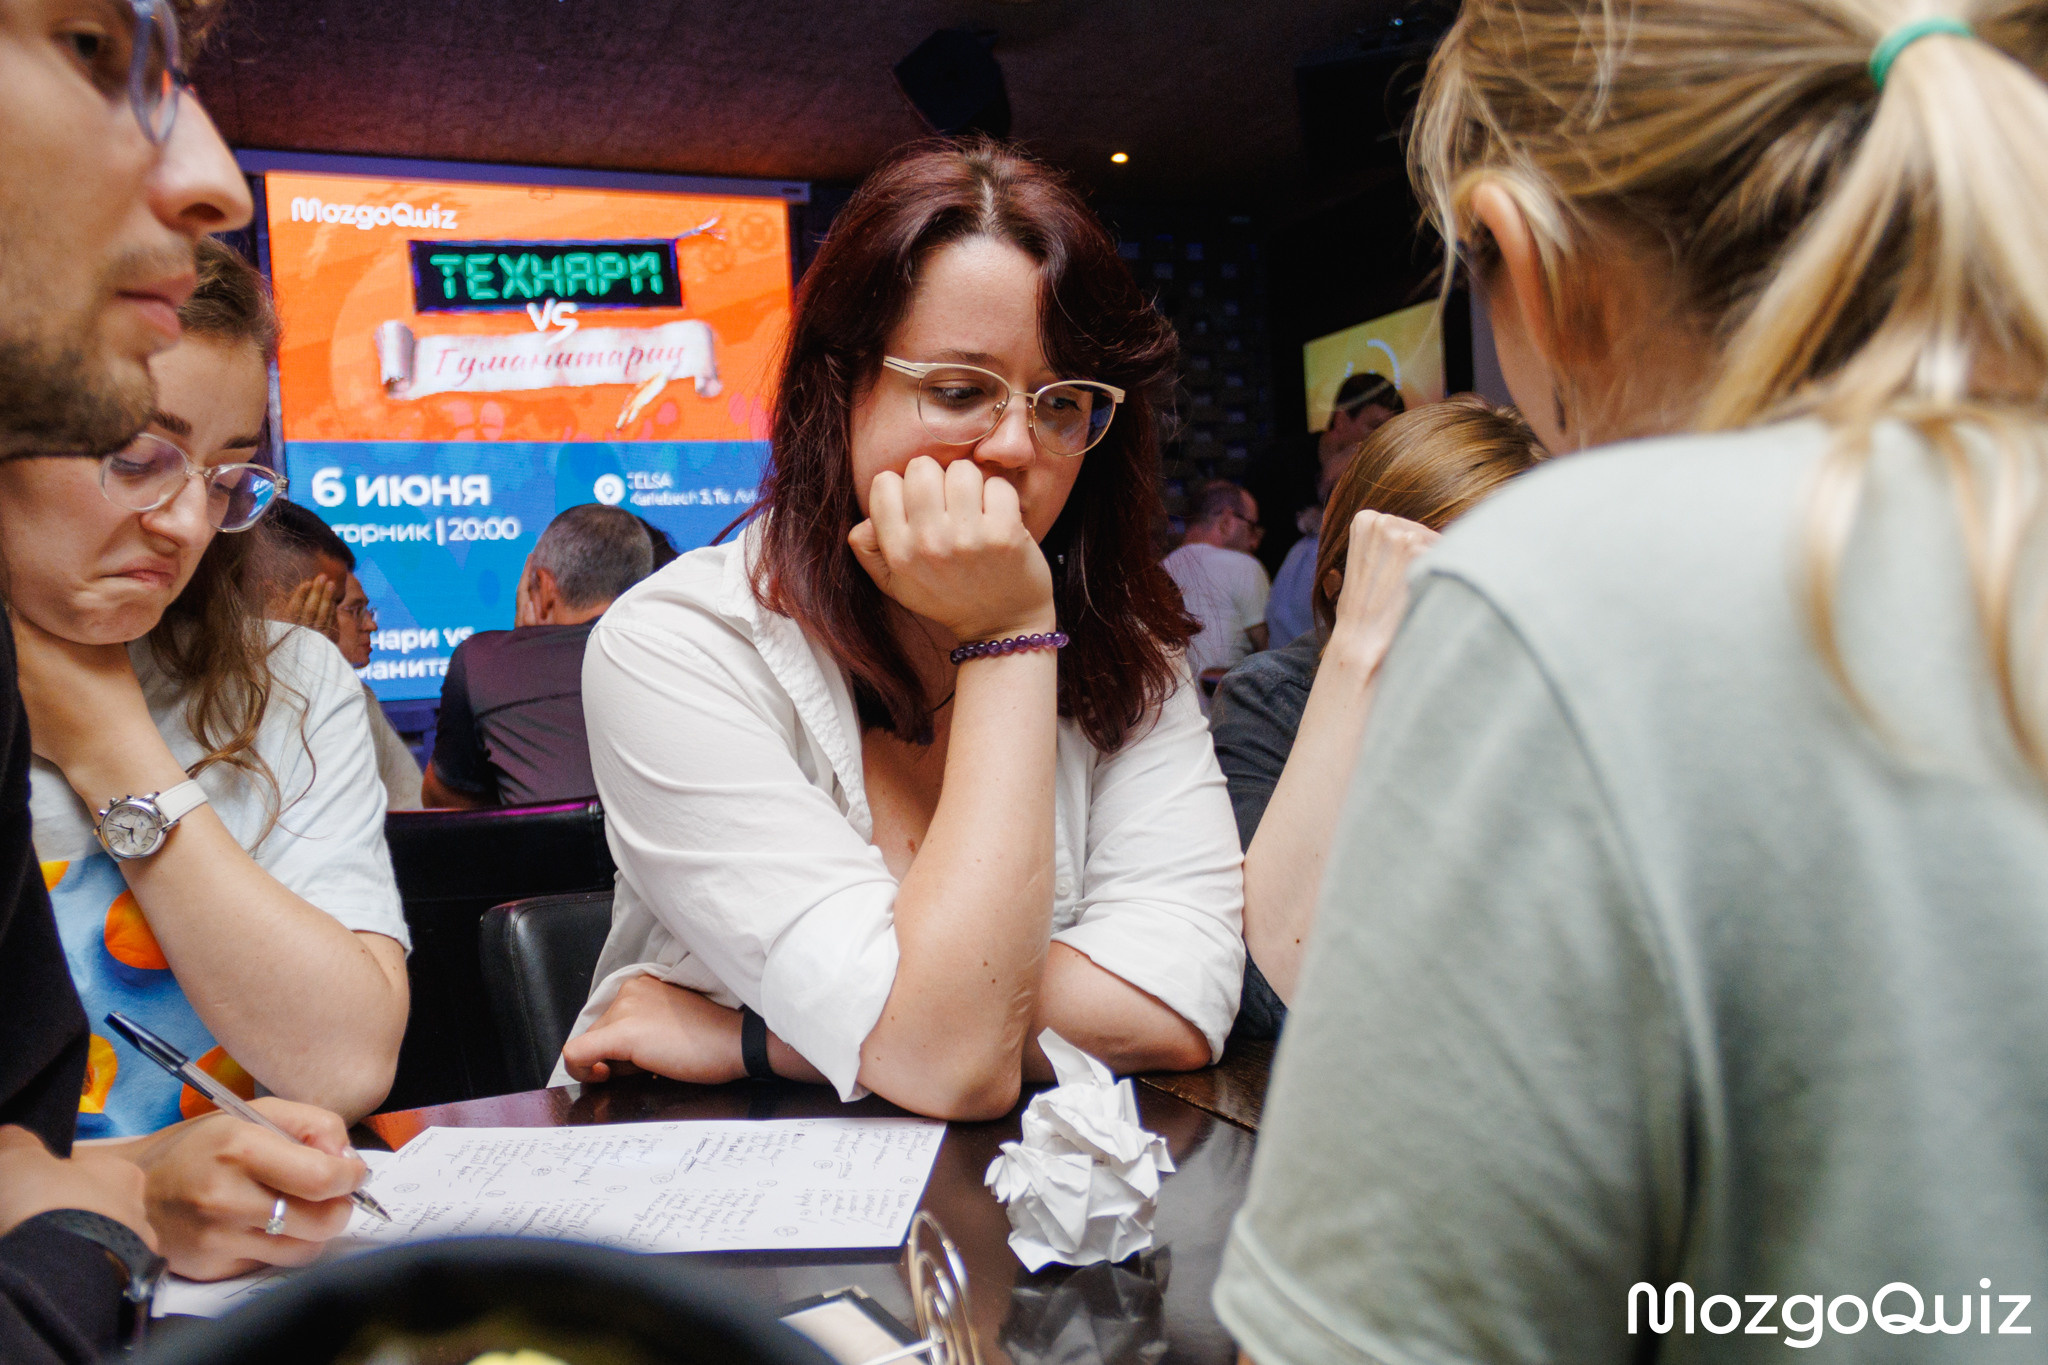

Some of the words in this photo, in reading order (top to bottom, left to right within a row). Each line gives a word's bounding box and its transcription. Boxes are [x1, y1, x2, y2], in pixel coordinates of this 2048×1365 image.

[291, 197, 458, 230] MozgoQuiz
[430, 252, 664, 300] ТЕХНАРИ
[311, 466, 347, 507] 6
[331, 523, 431, 547] торник
[447, 516, 521, 541] 20:00
